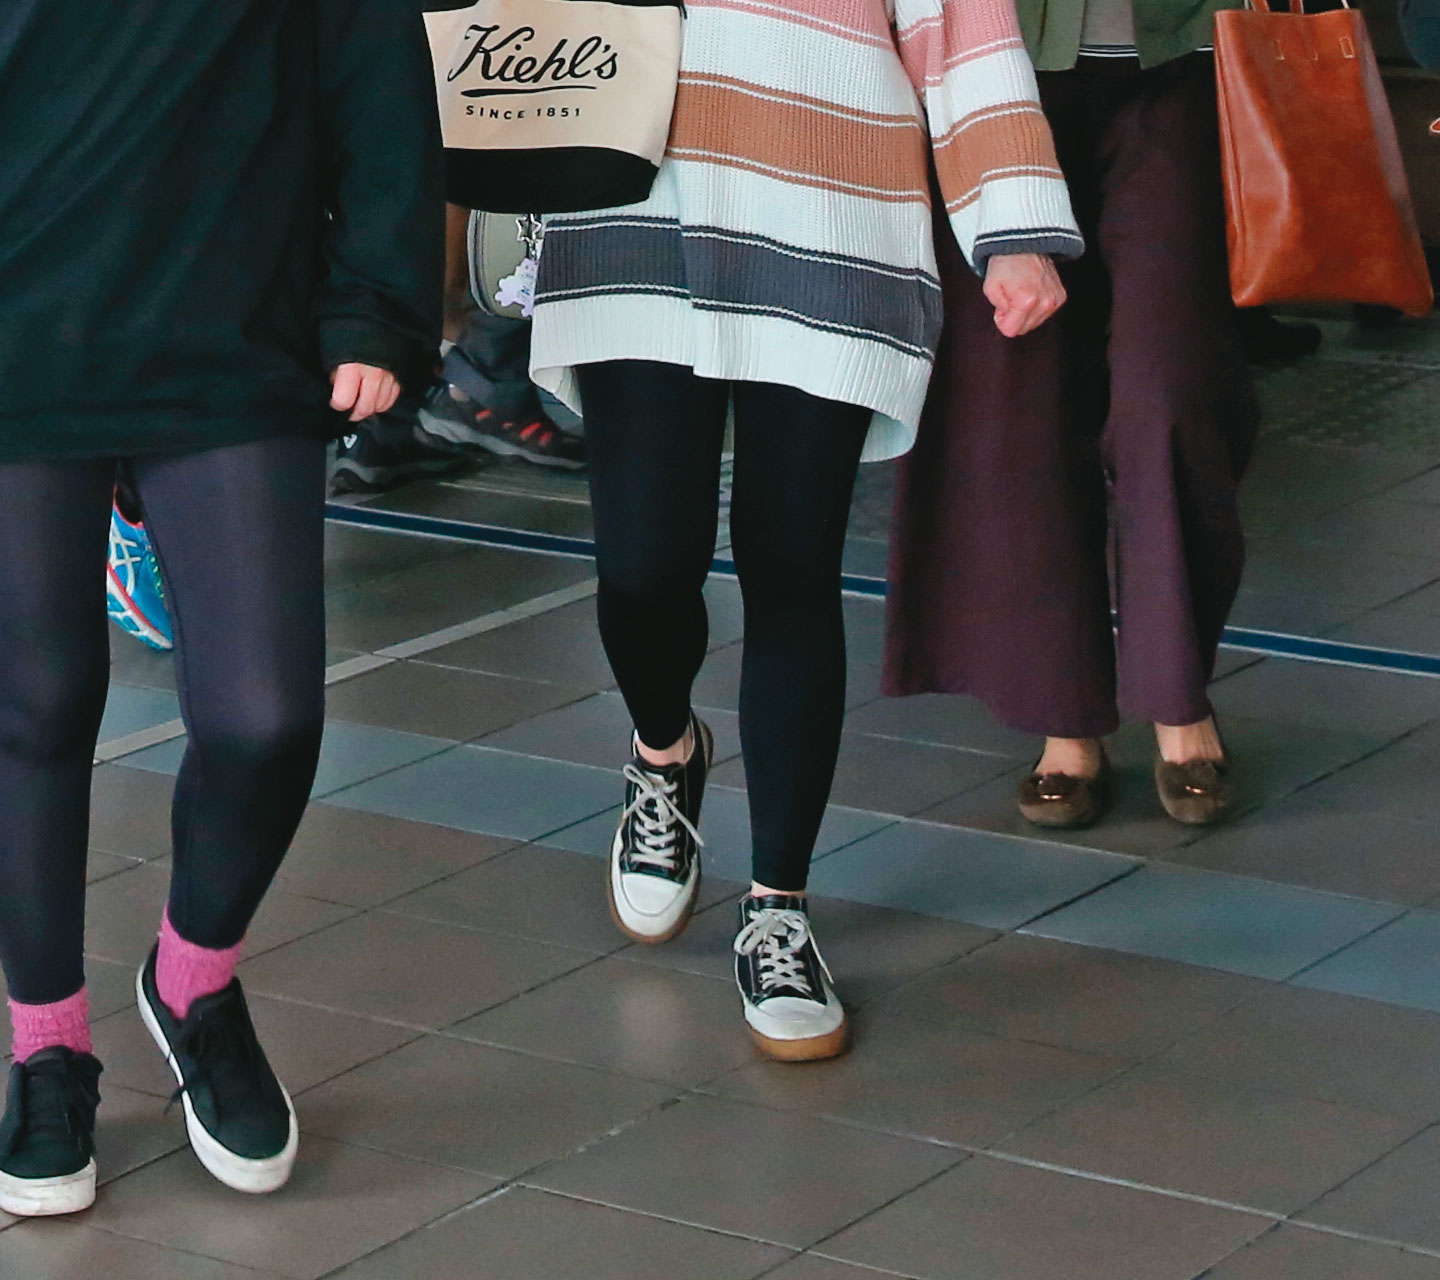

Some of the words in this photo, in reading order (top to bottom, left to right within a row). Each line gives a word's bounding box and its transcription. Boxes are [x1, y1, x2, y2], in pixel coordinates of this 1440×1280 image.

[446, 23, 620, 85] Kiehl's
[465, 104, 526, 121] SINCE
[536, 106, 583, 119] 1851
